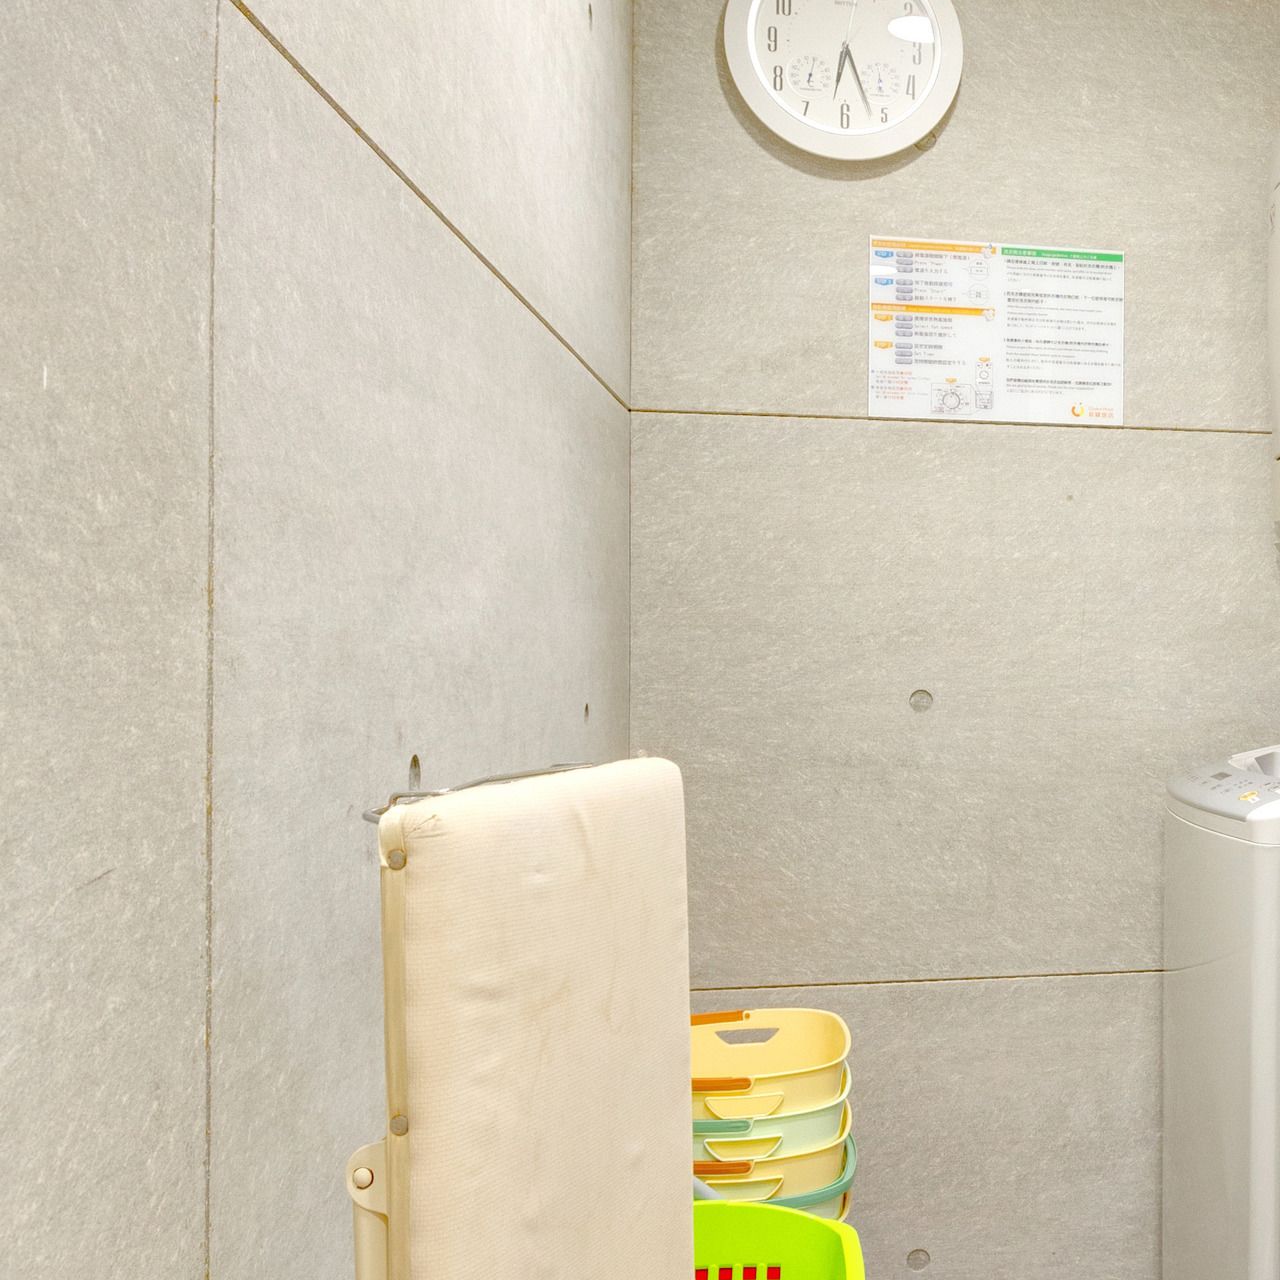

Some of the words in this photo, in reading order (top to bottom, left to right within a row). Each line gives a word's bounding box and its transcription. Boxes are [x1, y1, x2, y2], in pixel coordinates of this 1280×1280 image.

[767, 26, 778, 52] 9
[773, 65, 783, 91] 8
[905, 75, 916, 100] 4
[802, 100, 810, 116] 7
[840, 103, 850, 129] 6
[881, 107, 888, 123] 5
